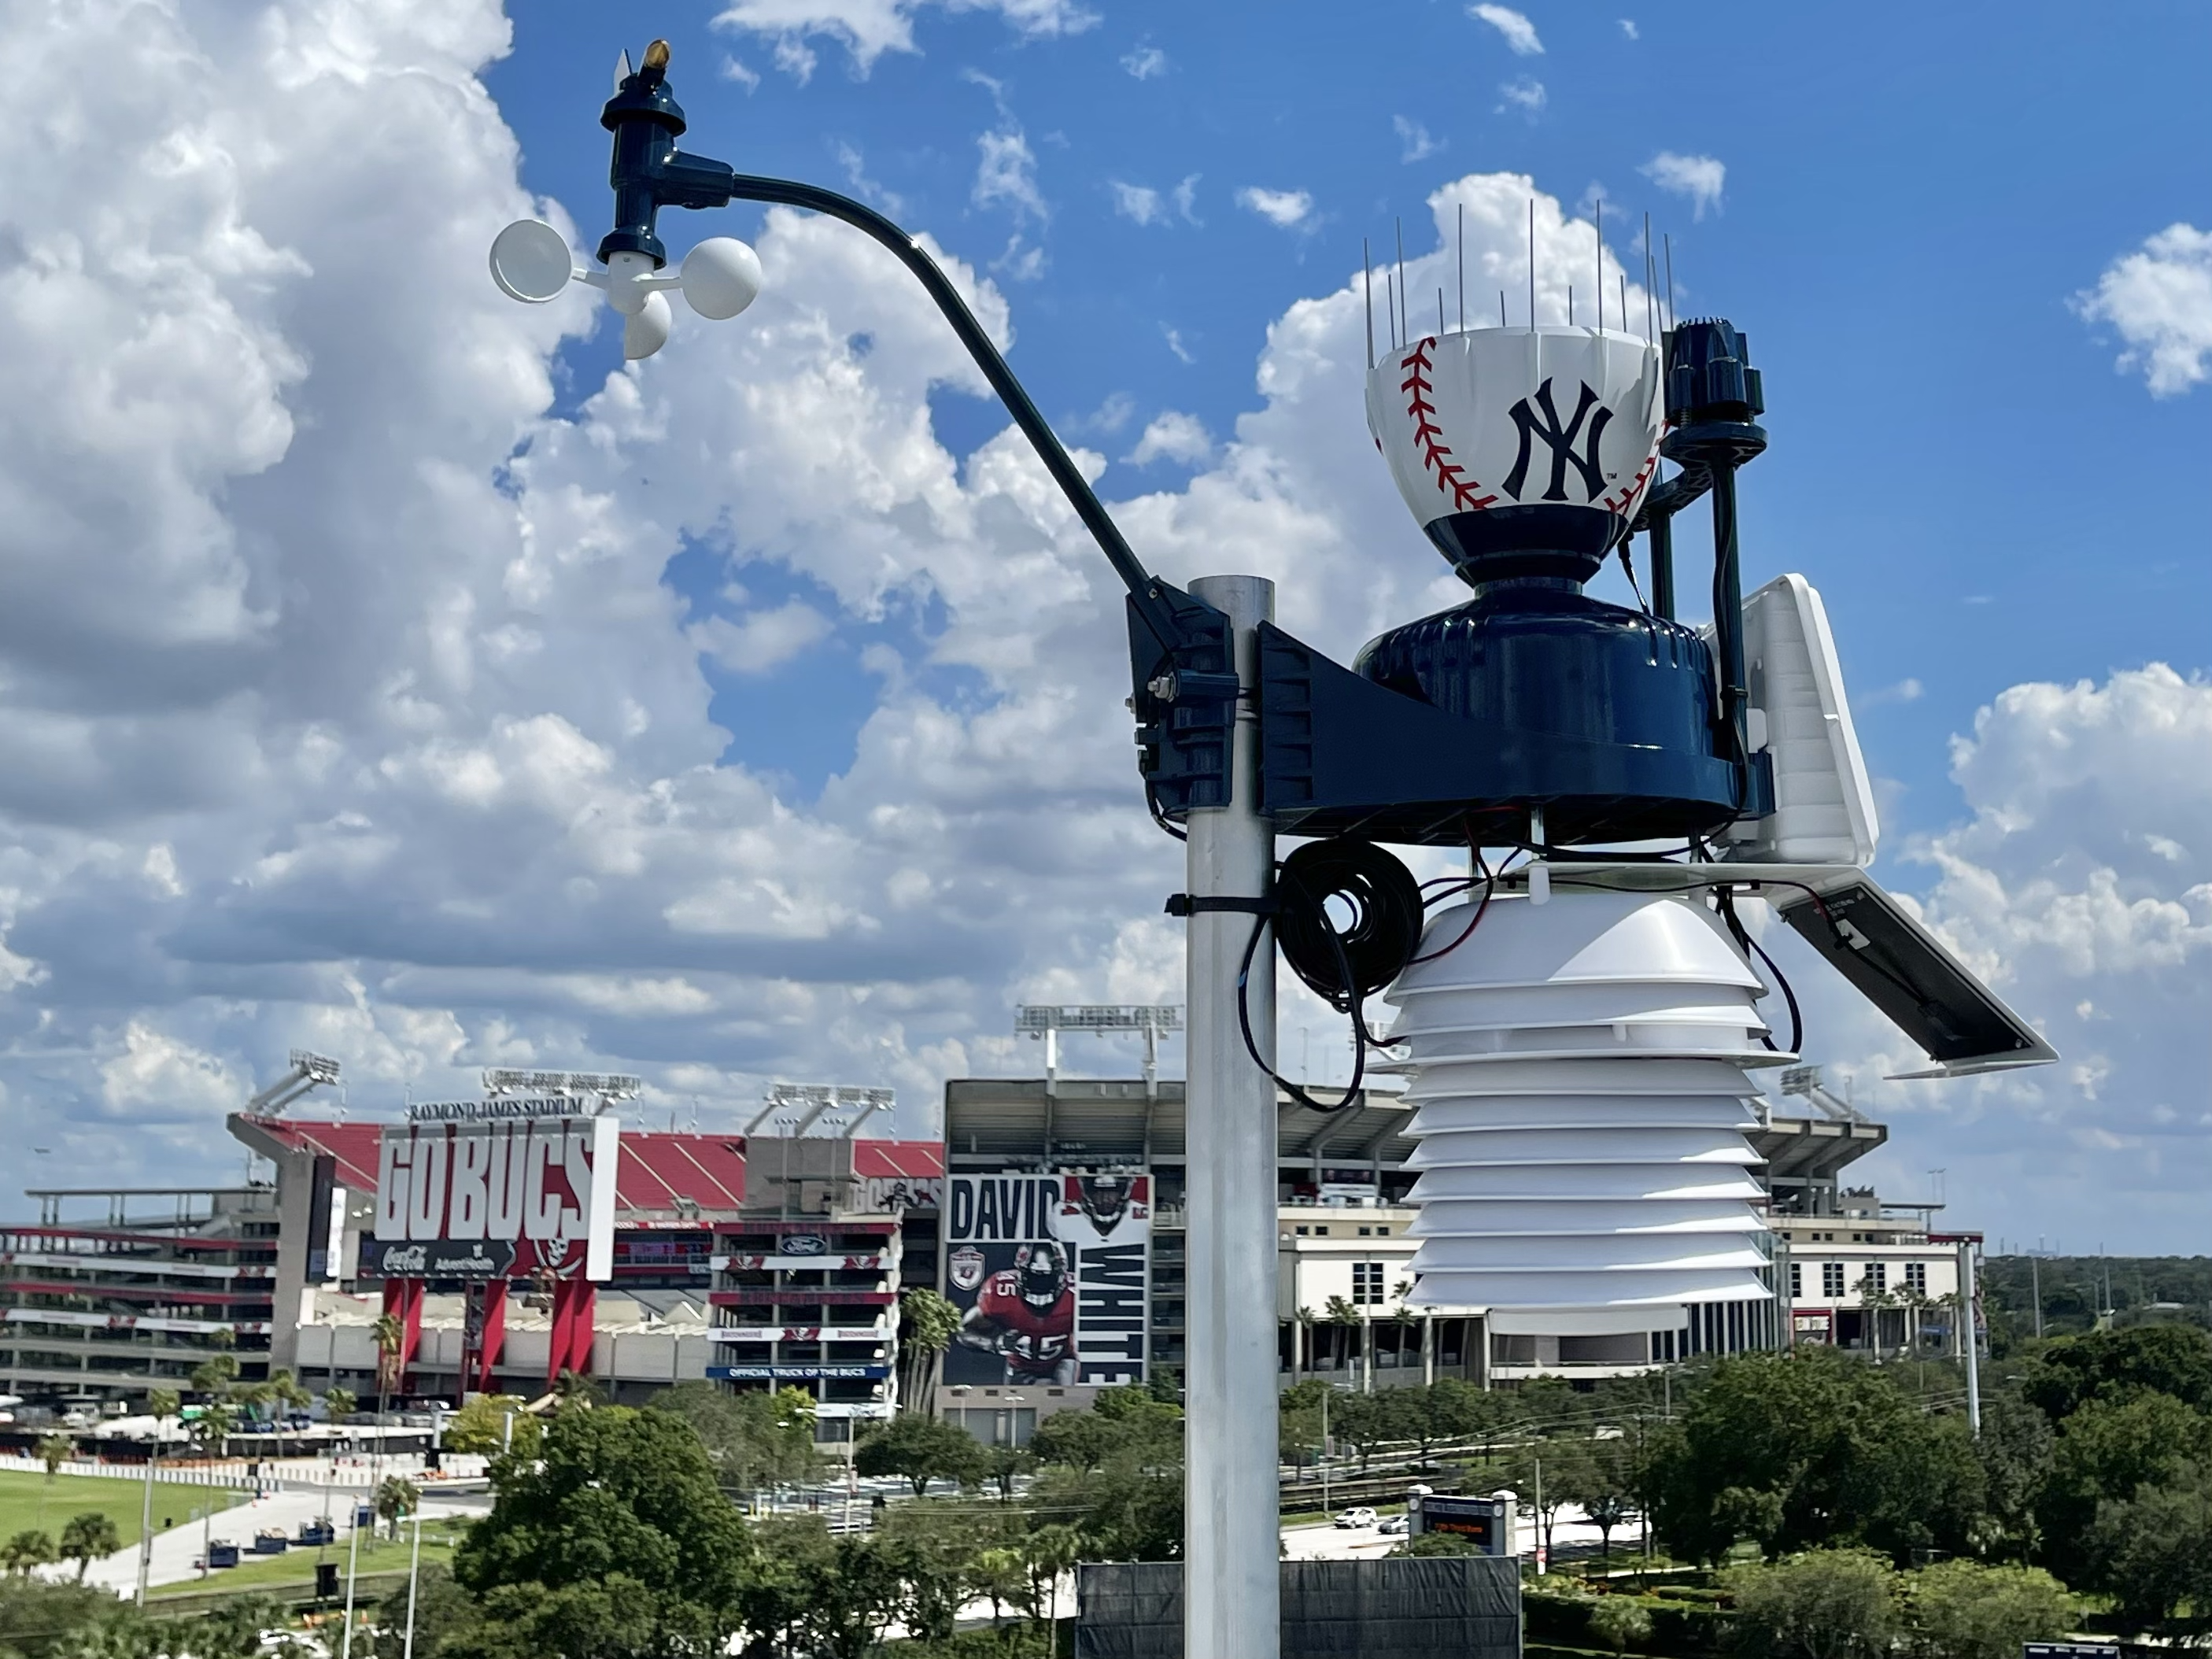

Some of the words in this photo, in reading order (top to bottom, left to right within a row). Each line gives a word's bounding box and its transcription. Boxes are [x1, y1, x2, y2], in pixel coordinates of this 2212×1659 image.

[409, 1101, 475, 1121] RAYMOND
[477, 1099, 522, 1118] JAMES
[523, 1096, 582, 1117] STADIUM
[375, 1125, 449, 1241] GO
[447, 1120, 594, 1240] BUCS
[950, 1179, 1061, 1240] DAVID
[1078, 1243, 1145, 1384] WHITE
[729, 1368, 771, 1377] OFFICIAL
[772, 1368, 804, 1376] TRUCK
[804, 1368, 819, 1376] OF
[820, 1368, 839, 1376] THE
[839, 1368, 866, 1376] BUCS
